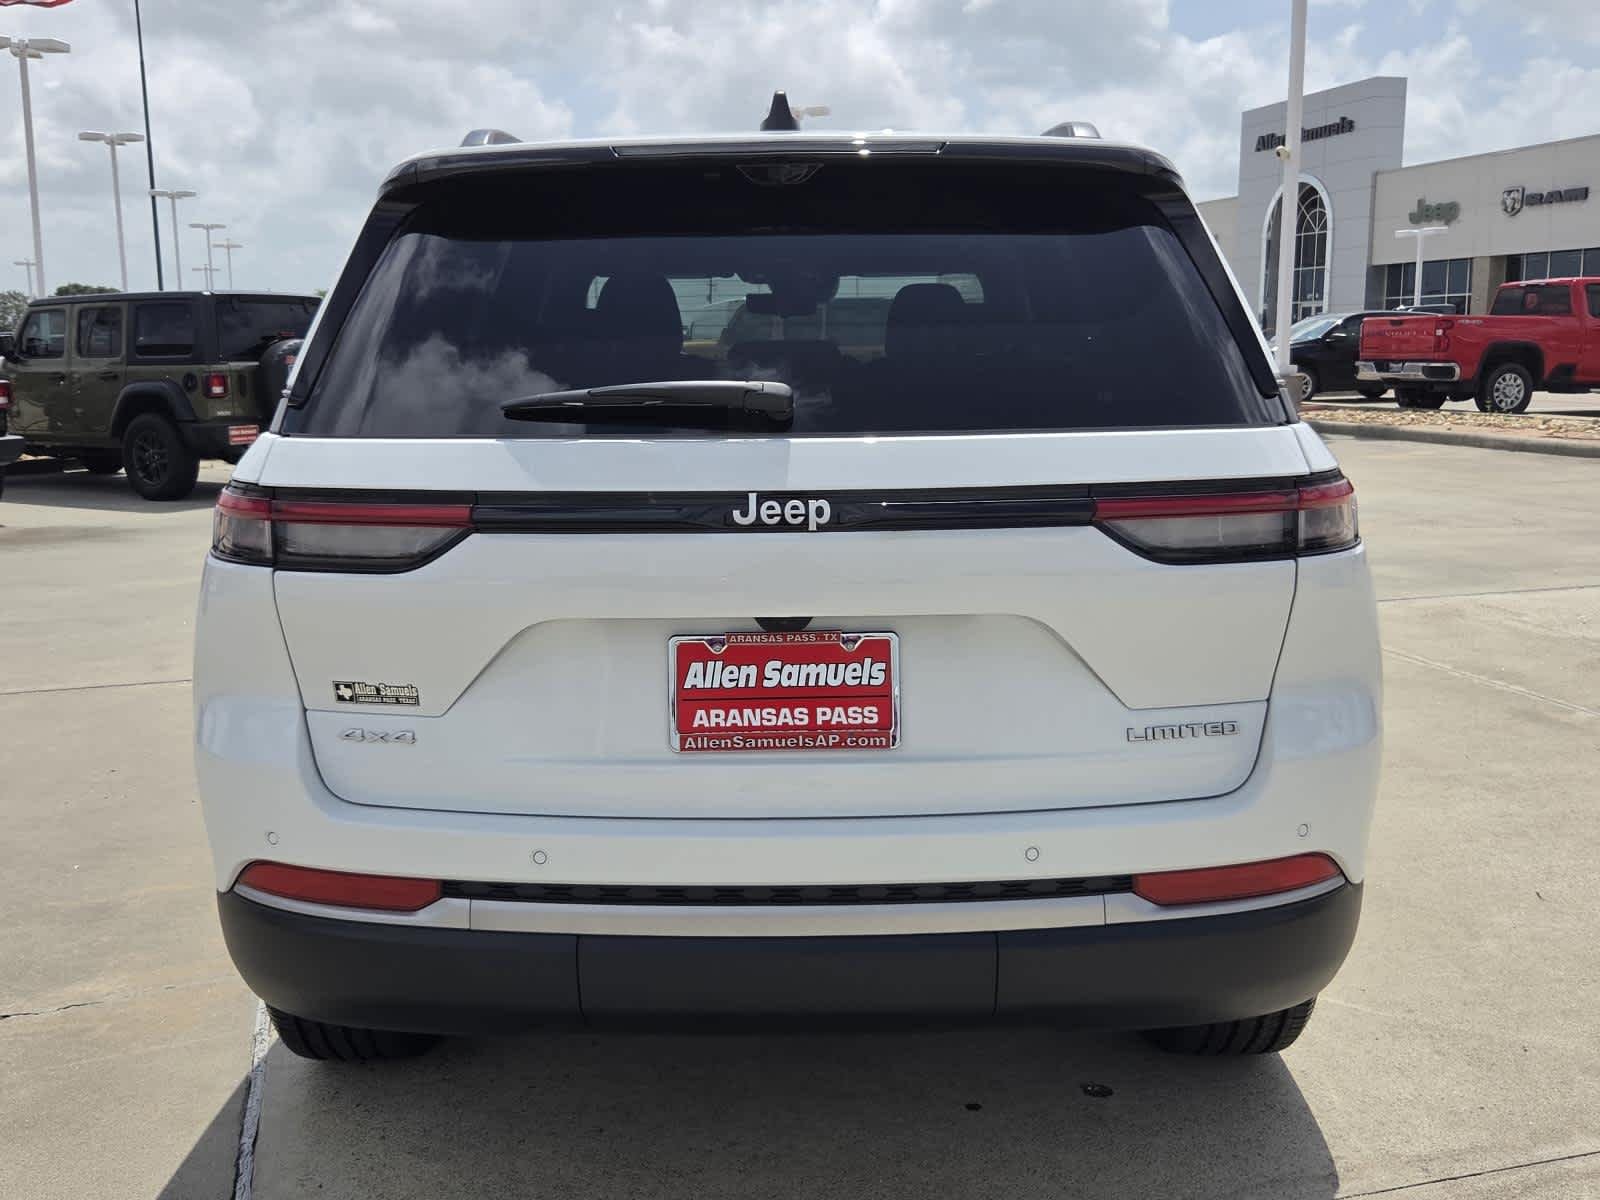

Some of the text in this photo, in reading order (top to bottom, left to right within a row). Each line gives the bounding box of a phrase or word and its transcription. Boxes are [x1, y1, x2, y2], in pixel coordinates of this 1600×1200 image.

[1301, 116, 1354, 143] amuels
[1525, 187, 1589, 206] RAM
[1409, 198, 1460, 225] Jeep
[732, 492, 831, 531] Jeep
[729, 634, 784, 643] ARANSAS
[824, 633, 839, 641] TX
[684, 657, 886, 689] Allen Samuels
[354, 683, 418, 697] Allen Samuels
[692, 706, 879, 728] ARANSAS PASS
[685, 735, 887, 750] AllenSamuelsAP.com
[1126, 720, 1240, 743] LIMITED
